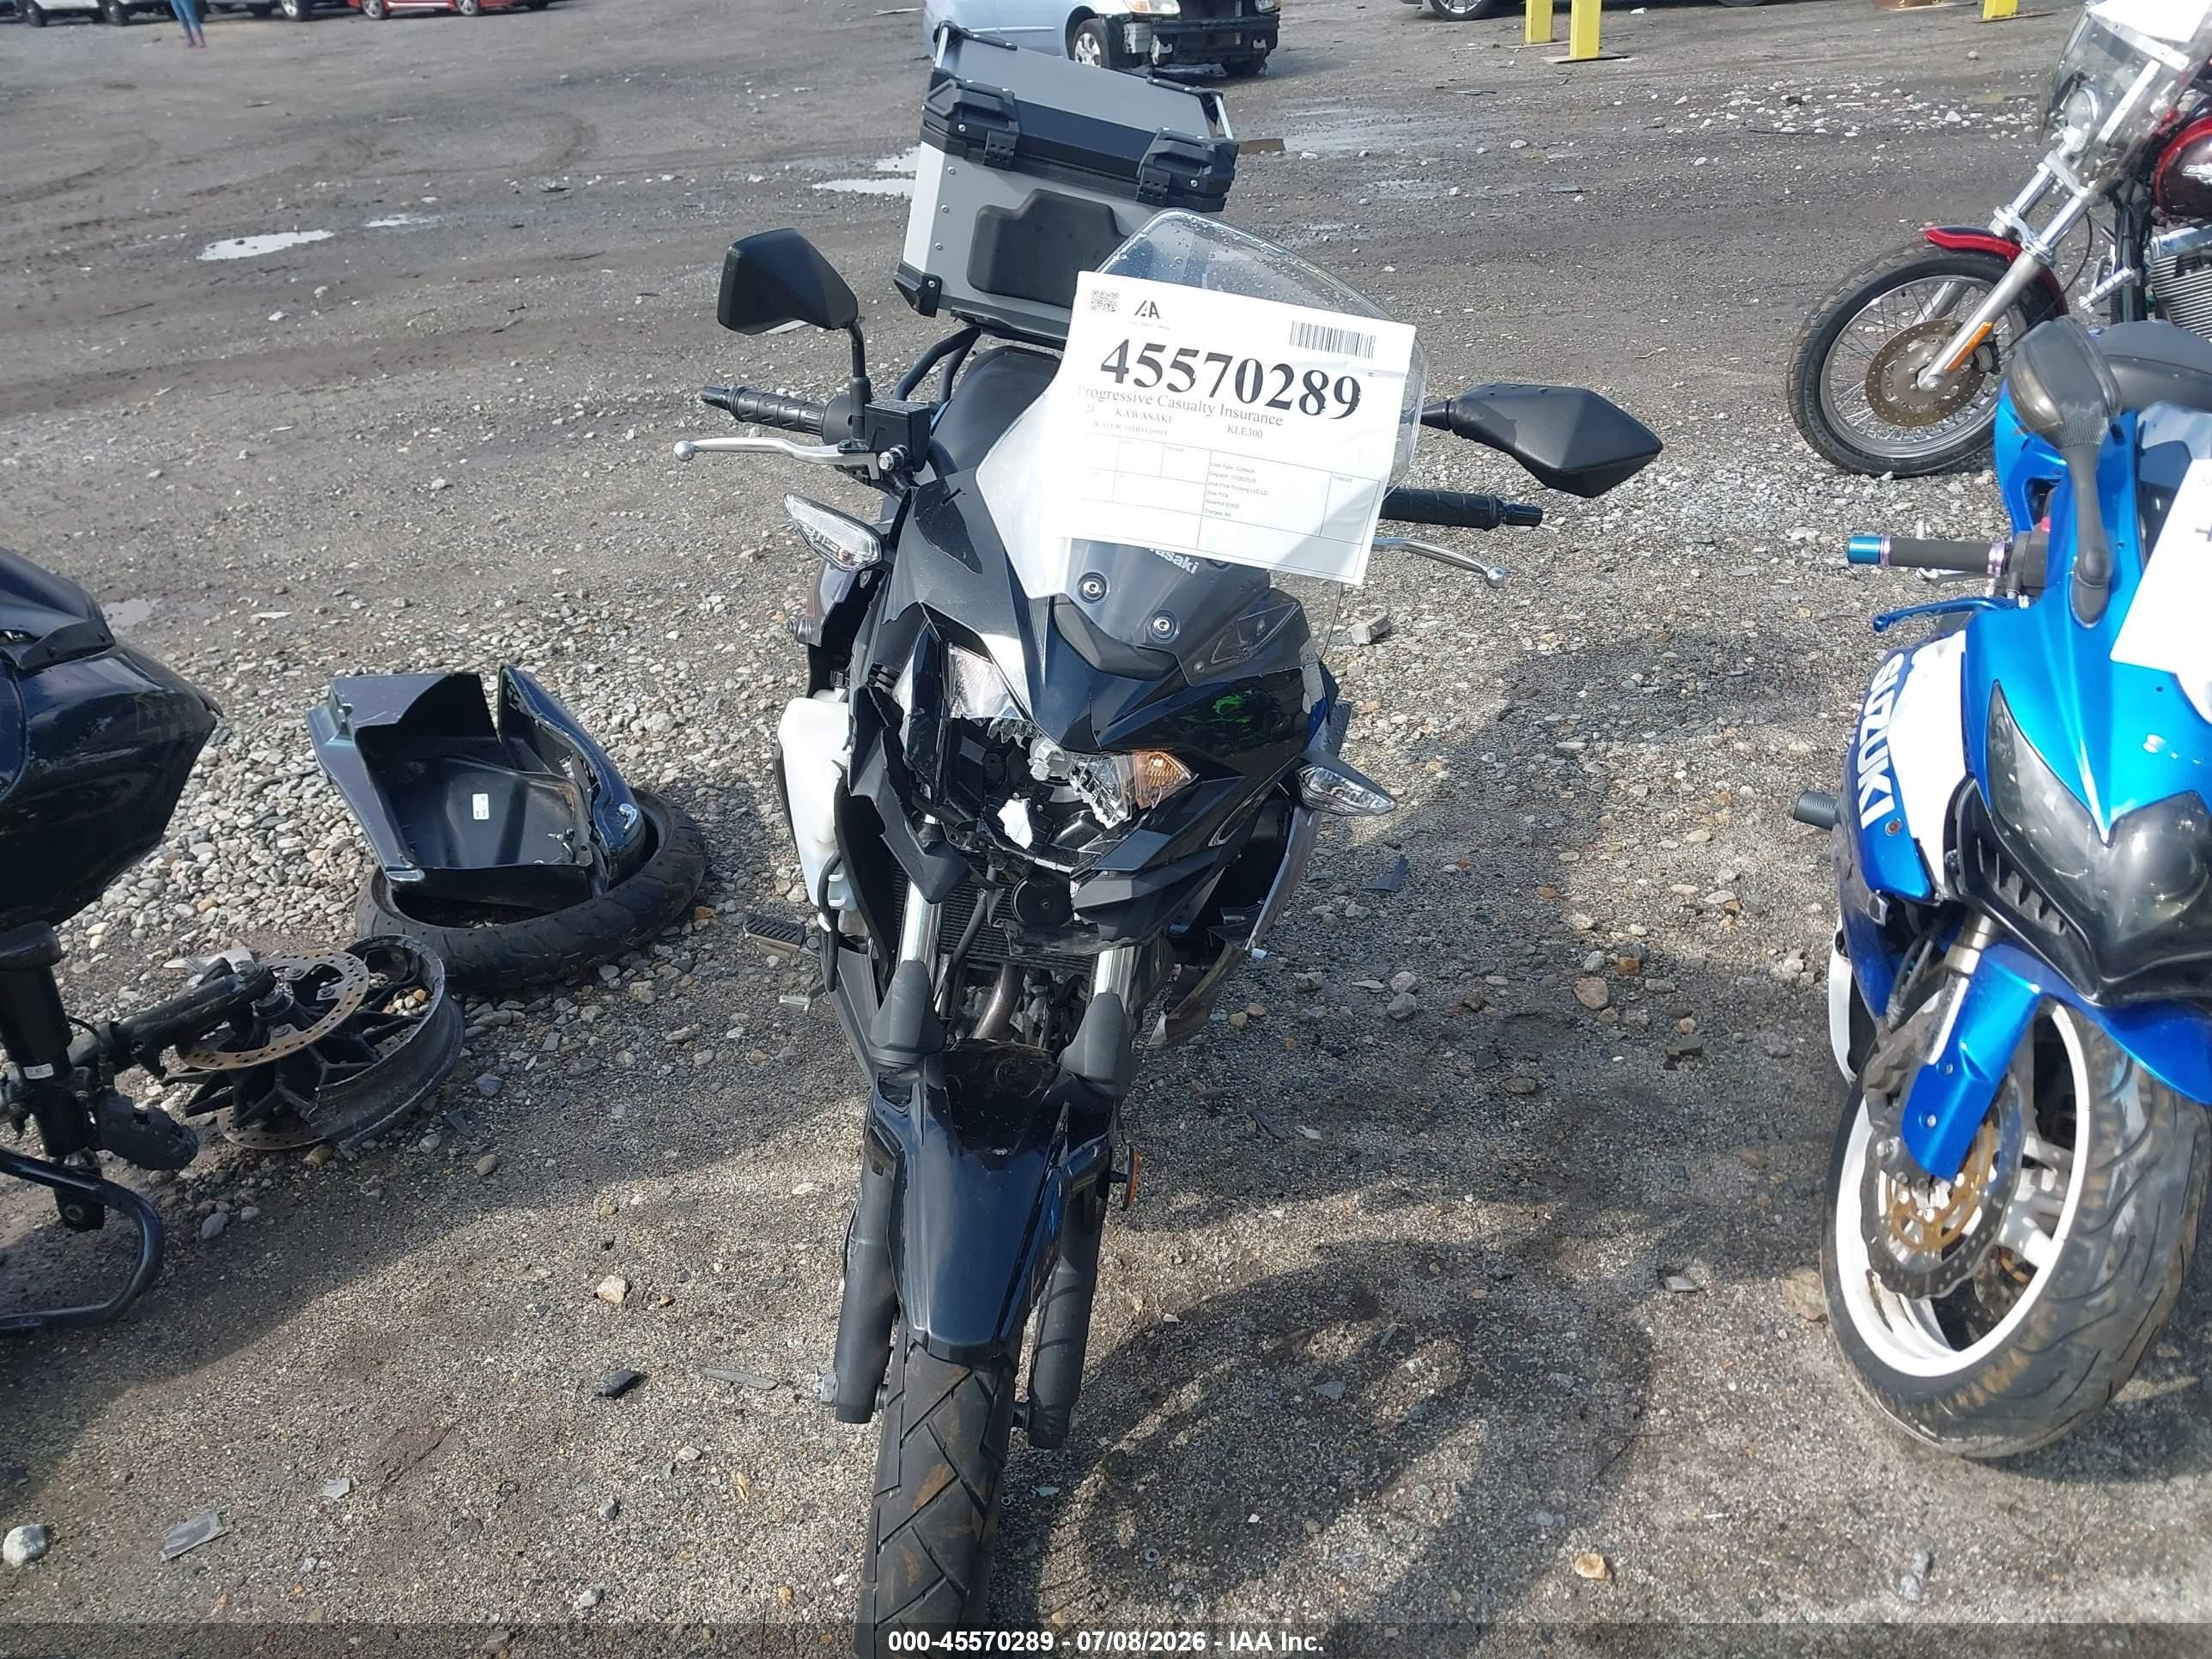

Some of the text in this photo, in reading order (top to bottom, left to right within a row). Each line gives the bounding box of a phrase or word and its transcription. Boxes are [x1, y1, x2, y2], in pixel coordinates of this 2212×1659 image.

[1079, 386, 1284, 427] Progressive Casualty Insurance
[1100, 338, 1362, 420] 45570289
[1115, 408, 1172, 424] KAWASAKI
[1856, 652, 1905, 830] SUZUKI
